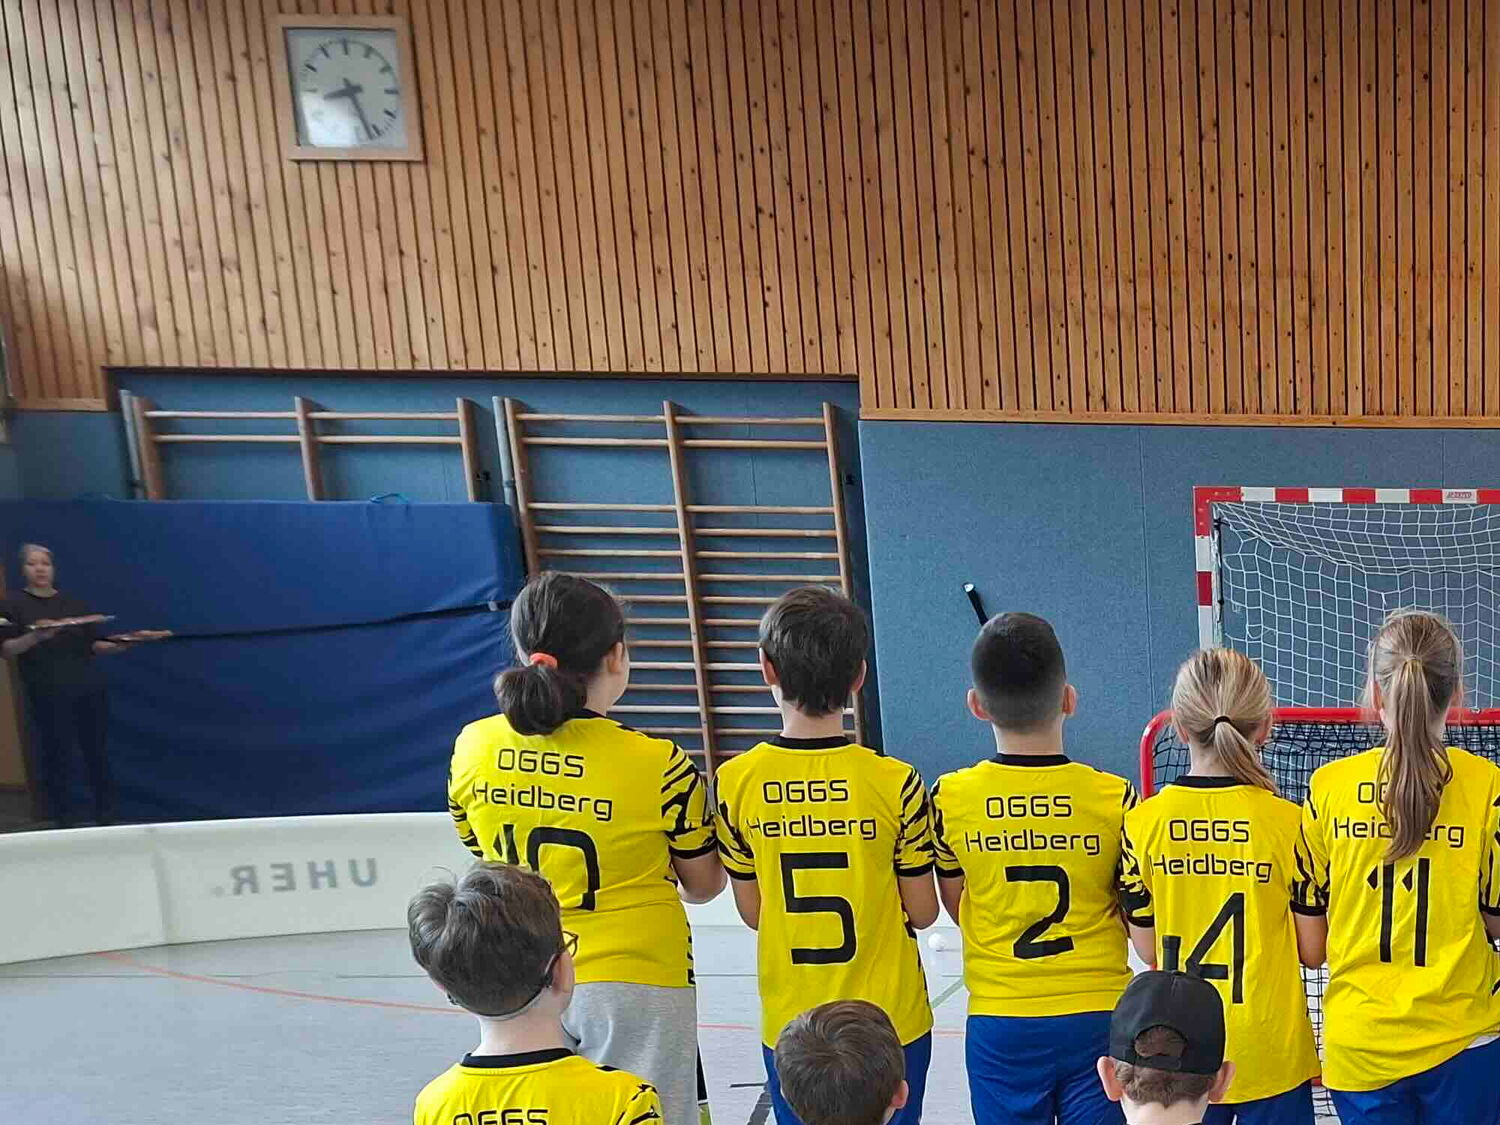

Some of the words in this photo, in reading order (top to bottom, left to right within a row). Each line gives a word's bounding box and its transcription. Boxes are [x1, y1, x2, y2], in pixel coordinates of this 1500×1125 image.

[498, 748, 585, 778] OGGS
[472, 781, 613, 822] Heidberg
[762, 779, 849, 804] OGGS
[986, 795, 1072, 819] OGGS
[745, 813, 877, 841] Heidberg
[965, 828, 1100, 856] Heidberg
[1169, 819, 1250, 843] OGGS
[1150, 853, 1273, 884] Heidberg
[779, 851, 857, 965] 5
[1004, 865, 1075, 960] 2
[1366, 857, 1430, 967] 11
[1184, 893, 1244, 1004] 4
